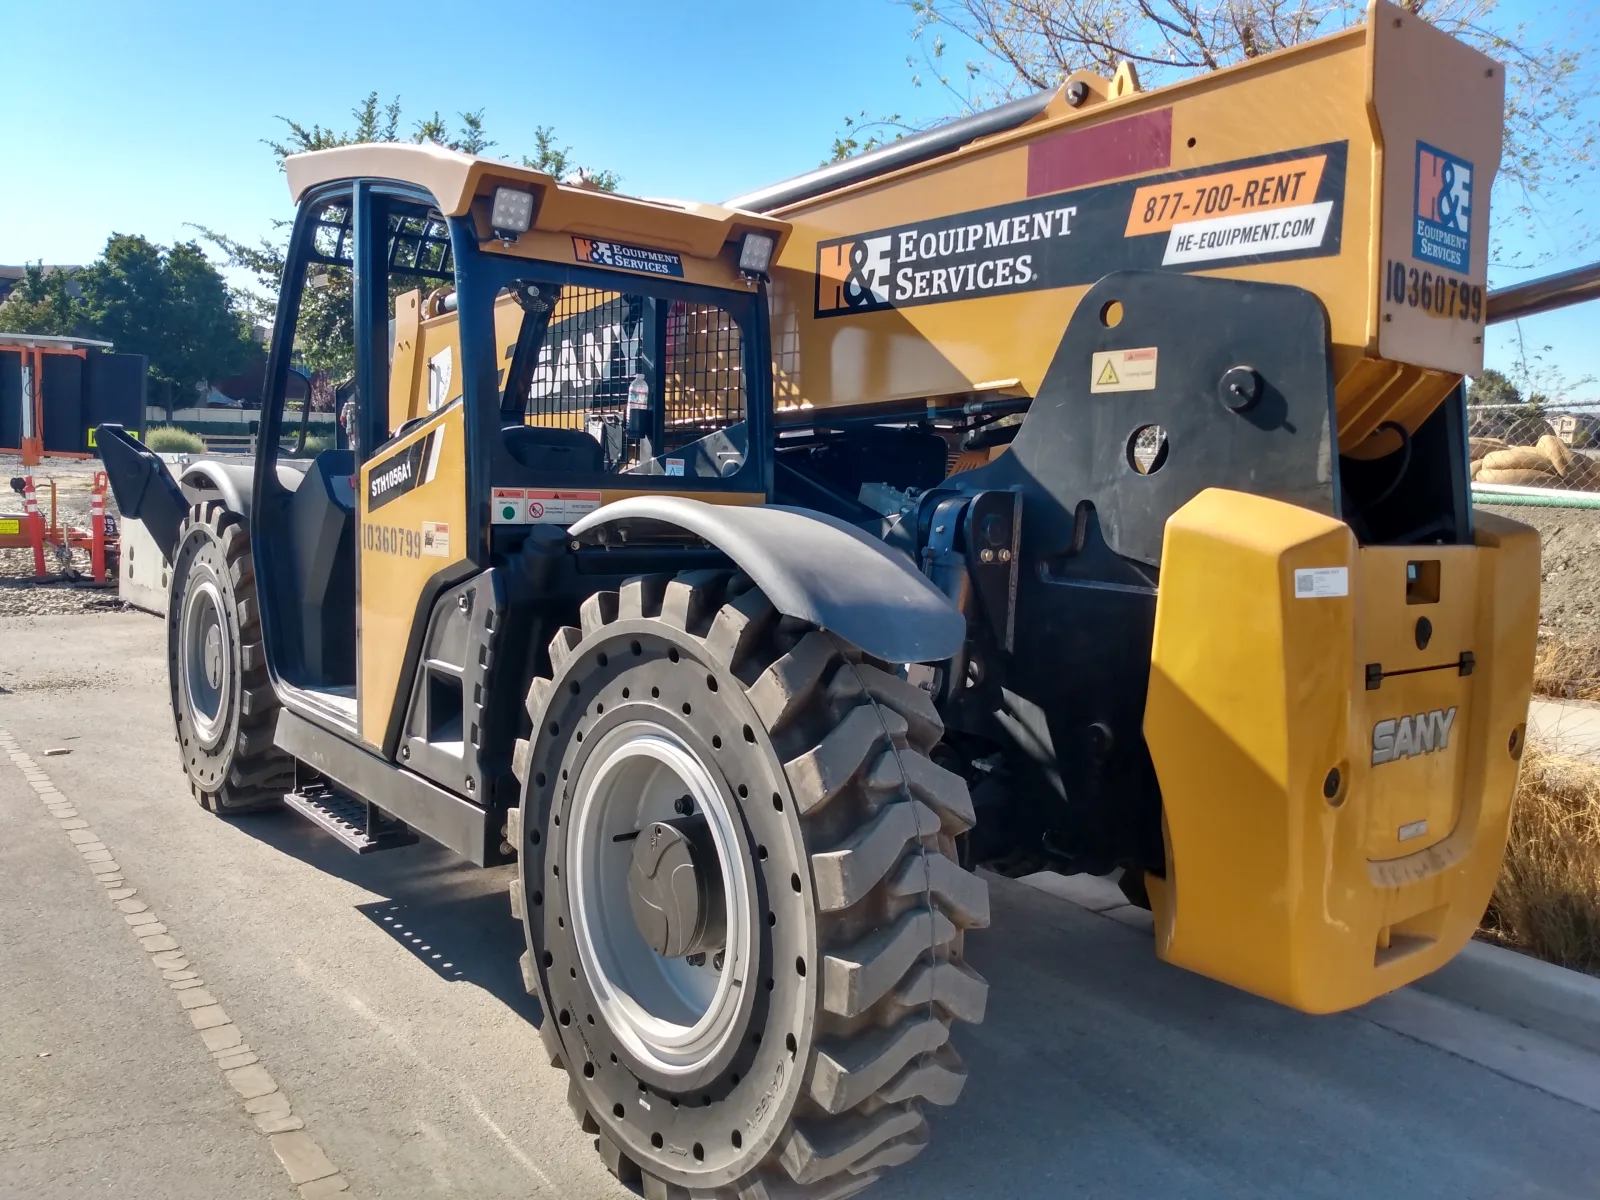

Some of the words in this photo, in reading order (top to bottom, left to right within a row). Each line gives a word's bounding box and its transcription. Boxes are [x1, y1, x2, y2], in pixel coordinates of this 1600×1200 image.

[1143, 171, 1307, 224] 877-700-RENT
[1419, 150, 1471, 233] H&E
[572, 238, 613, 265] H&E
[897, 206, 1077, 263] EQUIPMENT
[1175, 217, 1316, 253] HE-EQUIPMENT.COM
[1417, 220, 1468, 251] EQUIPMENT
[1421, 238, 1461, 265] SERVICES
[612, 244, 679, 265] EQUIPMENT
[615, 255, 669, 274] SERVICES
[819, 235, 891, 311] H&E
[896, 255, 1033, 301] SERVICES
[1386, 260, 1482, 324] 10360799
[371, 460, 412, 497] STH1056A1
[363, 523, 421, 560] 10360799
[1371, 705, 1458, 768] SANY
